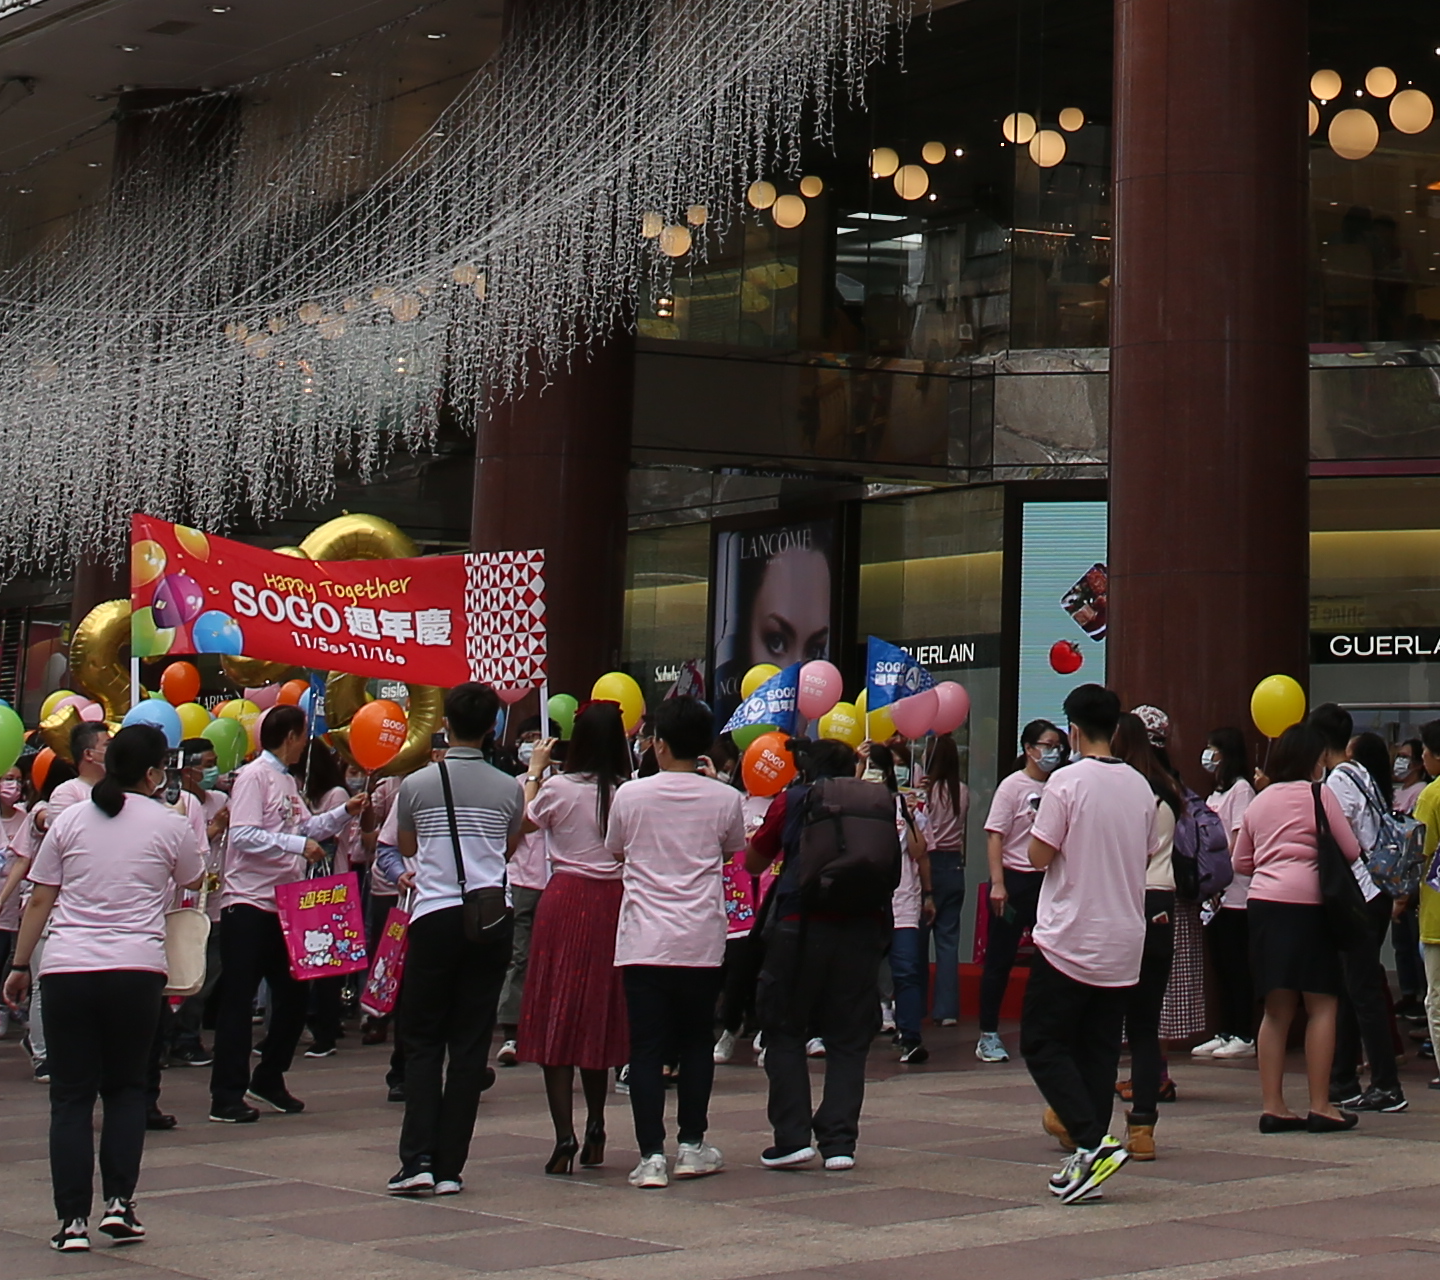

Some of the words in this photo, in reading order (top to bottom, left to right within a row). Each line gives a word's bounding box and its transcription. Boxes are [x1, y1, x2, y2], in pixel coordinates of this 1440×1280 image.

[739, 528, 813, 561] LANCÔME
[263, 571, 317, 604] Happy
[319, 575, 413, 607] Together
[230, 580, 344, 635] SOGO
[344, 605, 453, 646] 週年慶
[766, 686, 797, 701] SOGO
[382, 717, 406, 731] SOGO
[761, 748, 786, 770] SOGO
[298, 885, 348, 911] 週年慶
